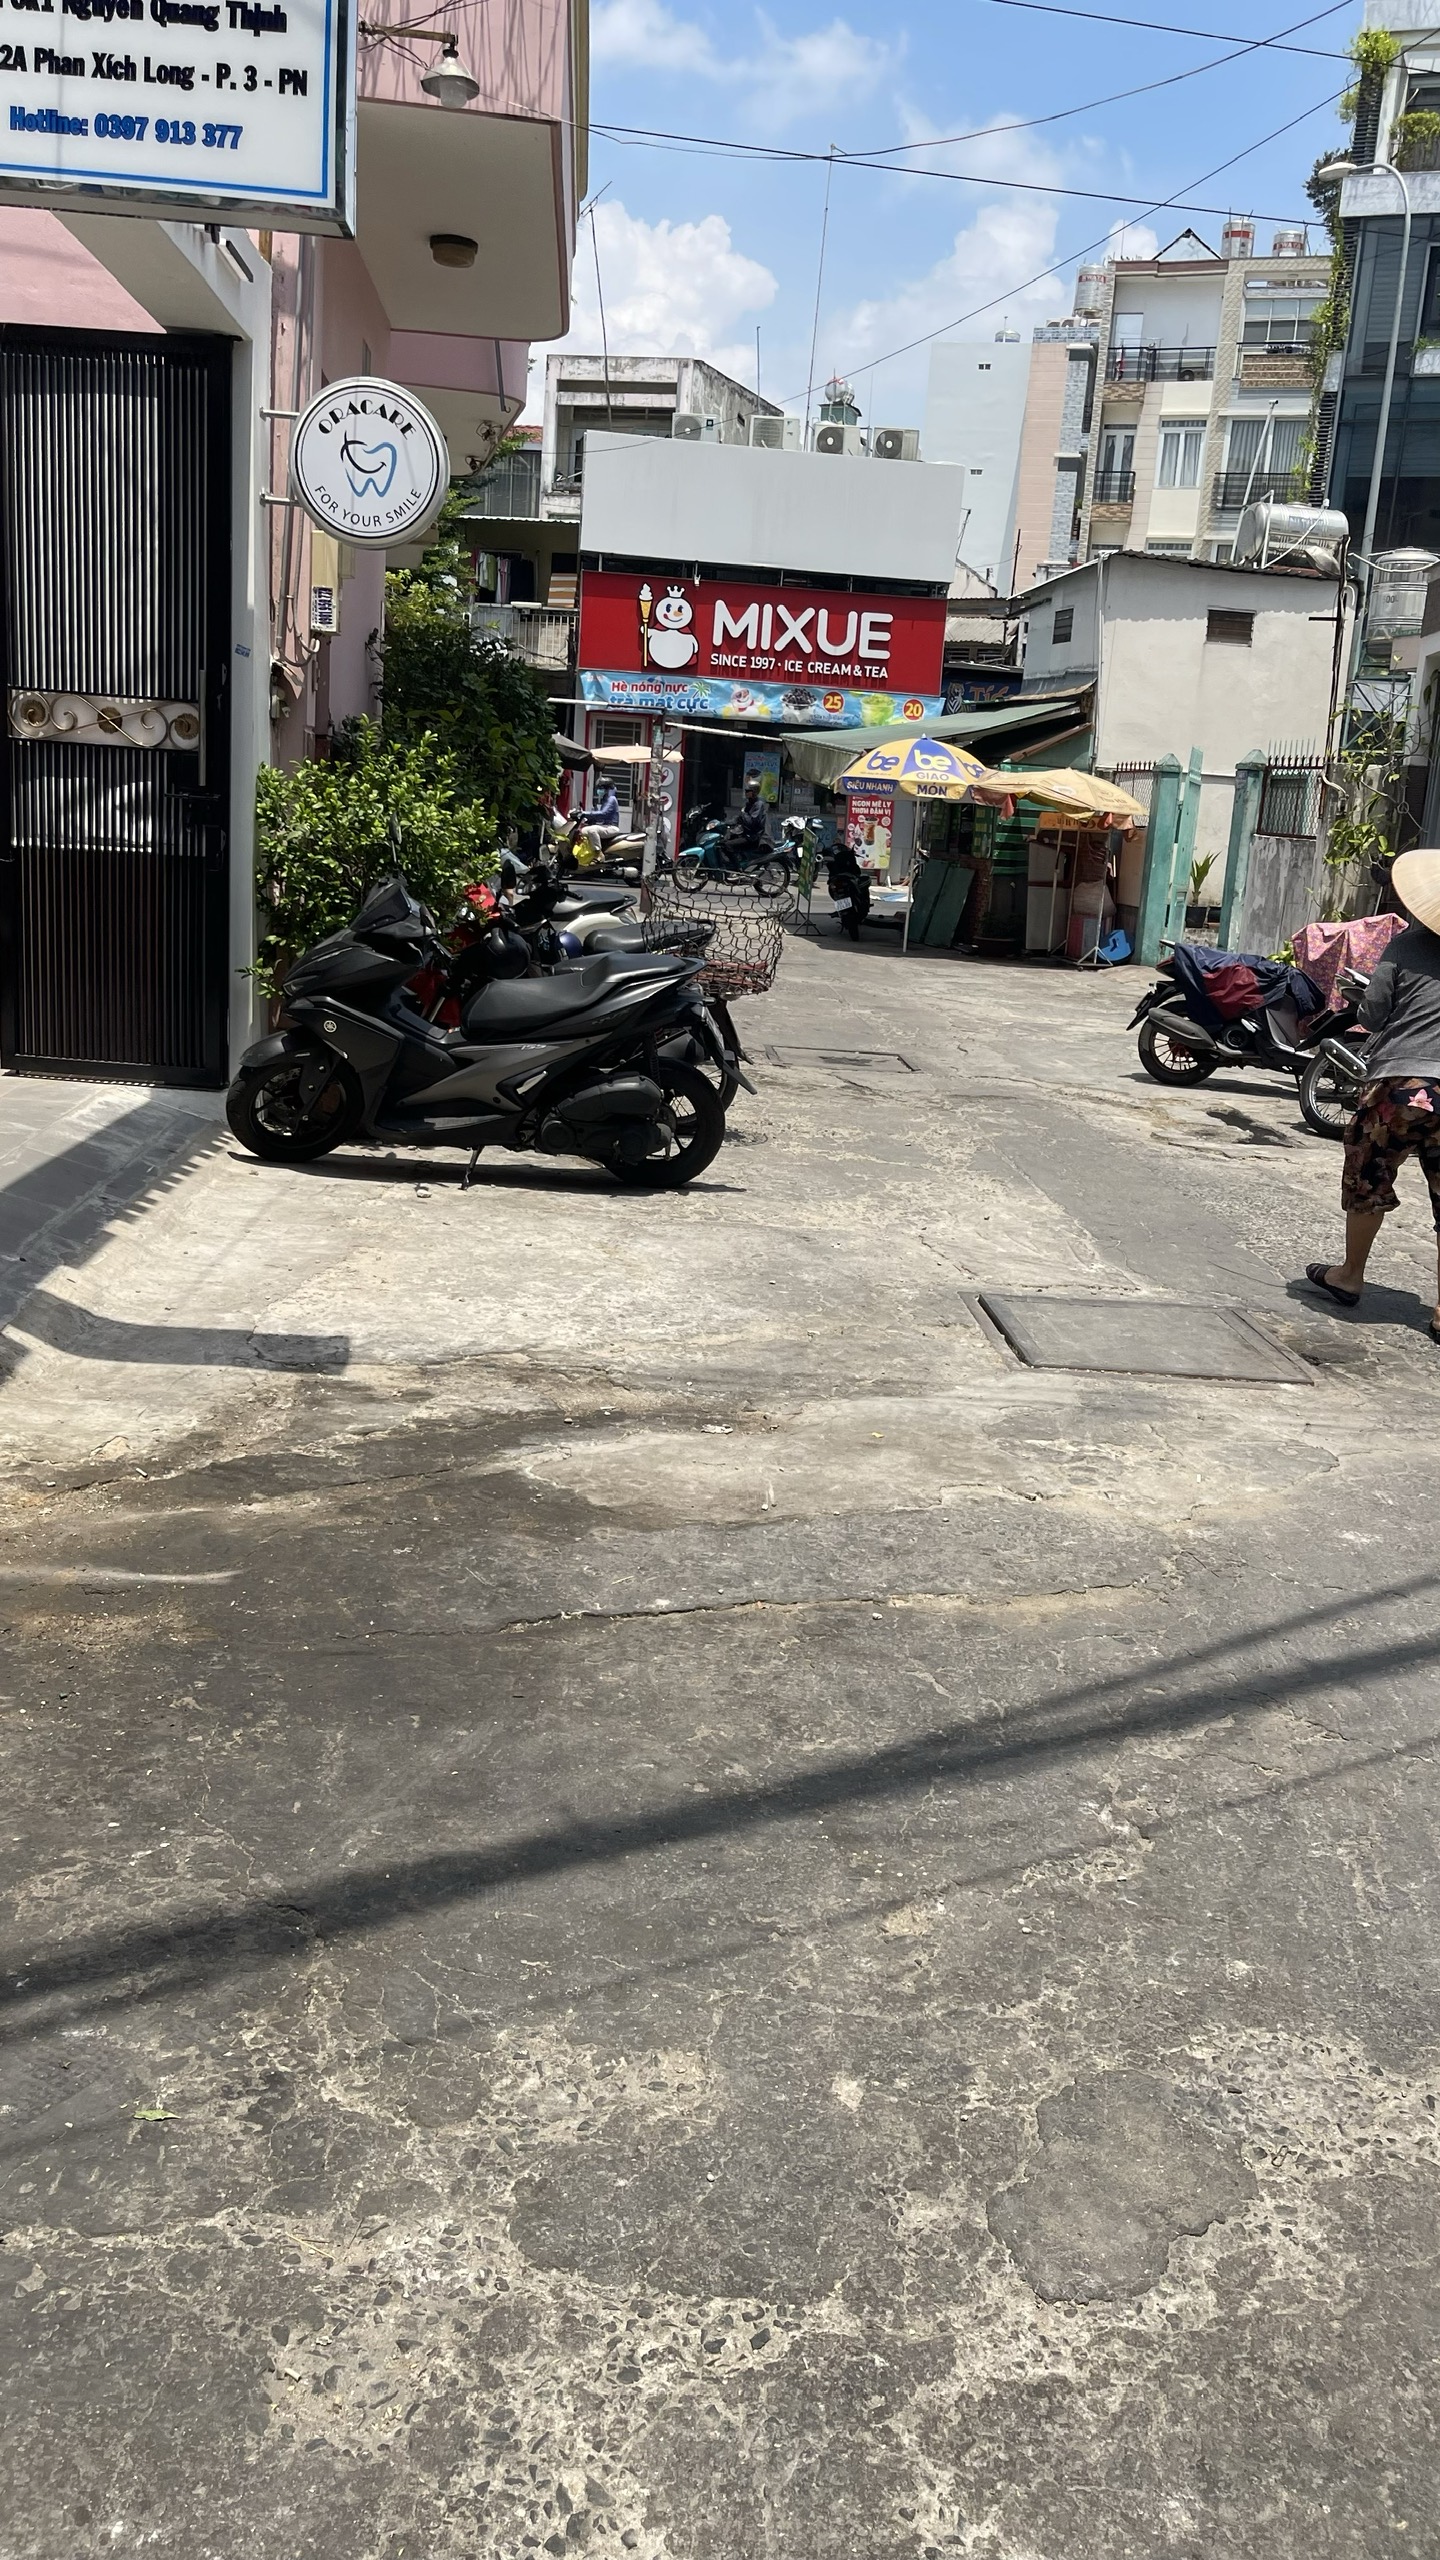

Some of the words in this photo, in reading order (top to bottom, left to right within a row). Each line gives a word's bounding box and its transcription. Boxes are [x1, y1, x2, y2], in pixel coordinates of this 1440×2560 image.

[150, 0, 220, 32] Quang
[226, 0, 287, 37] Thịnh
[34, 47, 85, 77] Phan
[91, 51, 137, 82] Xích
[144, 56, 195, 91] Long
[216, 62, 237, 90] P.
[243, 65, 258, 92] 3
[279, 68, 308, 96] PN
[10, 106, 88, 136] Hotline:
[94, 112, 149, 141] 0397
[155, 119, 196, 146] 913
[201, 123, 243, 149] 377
[318, 399, 417, 440] ORACARE
[314, 485, 339, 513] FOR
[341, 508, 382, 527] YOUR
[385, 488, 422, 524] SMILE
[712, 599, 894, 660] MIXUE
[710, 653, 747, 668] SINCE
[750, 656, 776, 670] 1997
[784, 659, 803, 672] ICE
[807, 661, 851, 676] CREAM
[853, 664, 862, 676] &
[864, 665, 888, 679] TEA
[611, 681, 628, 692] Hè
[631, 682, 661, 695] nóng
[665, 683, 688, 695] nực
[677, 698, 709, 713] cực
[825, 695, 842, 709] 25
[904, 702, 922, 716] 20
[867, 750, 900, 771] be
[914, 749, 952, 771] be
[847, 780, 865, 790] SIÊU
[866, 782, 894, 792] NHANH
[916, 772, 949, 781] GIAO
[917, 782, 948, 797] MÓN
